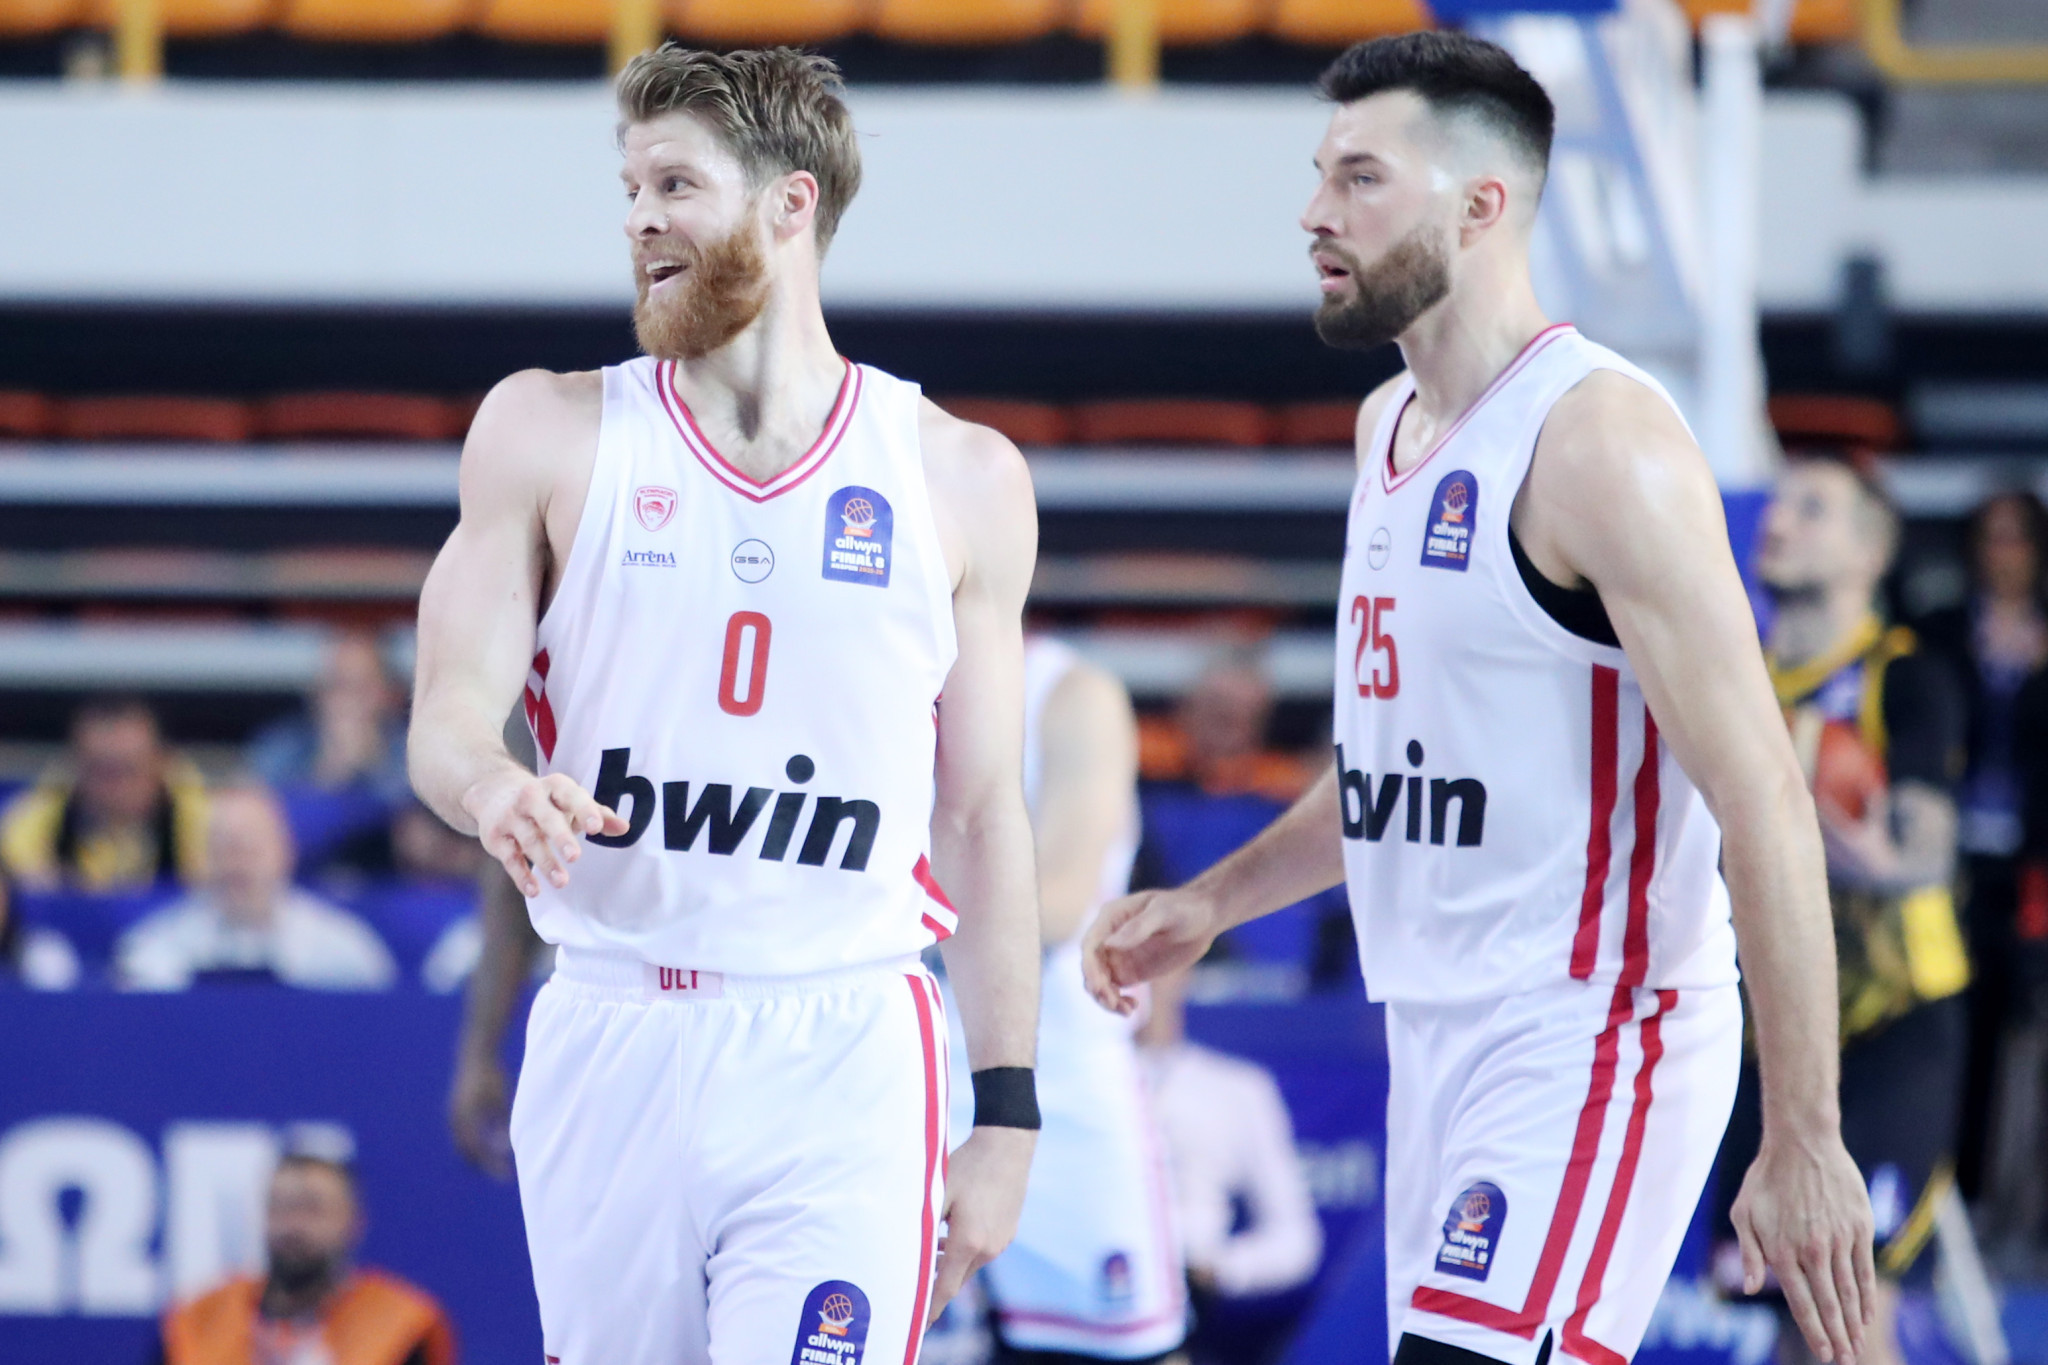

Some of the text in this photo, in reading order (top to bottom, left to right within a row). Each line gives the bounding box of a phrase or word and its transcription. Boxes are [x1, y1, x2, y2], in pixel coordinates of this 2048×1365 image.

[835, 535, 882, 556] allwyn
[735, 556, 771, 565] GSA
[831, 550, 873, 568] FINAL
[875, 556, 885, 569] 8
[1351, 595, 1400, 700] 25
[718, 610, 772, 717] 0
[585, 747, 881, 872] bwin
[807, 1332, 856, 1355] allwyn
